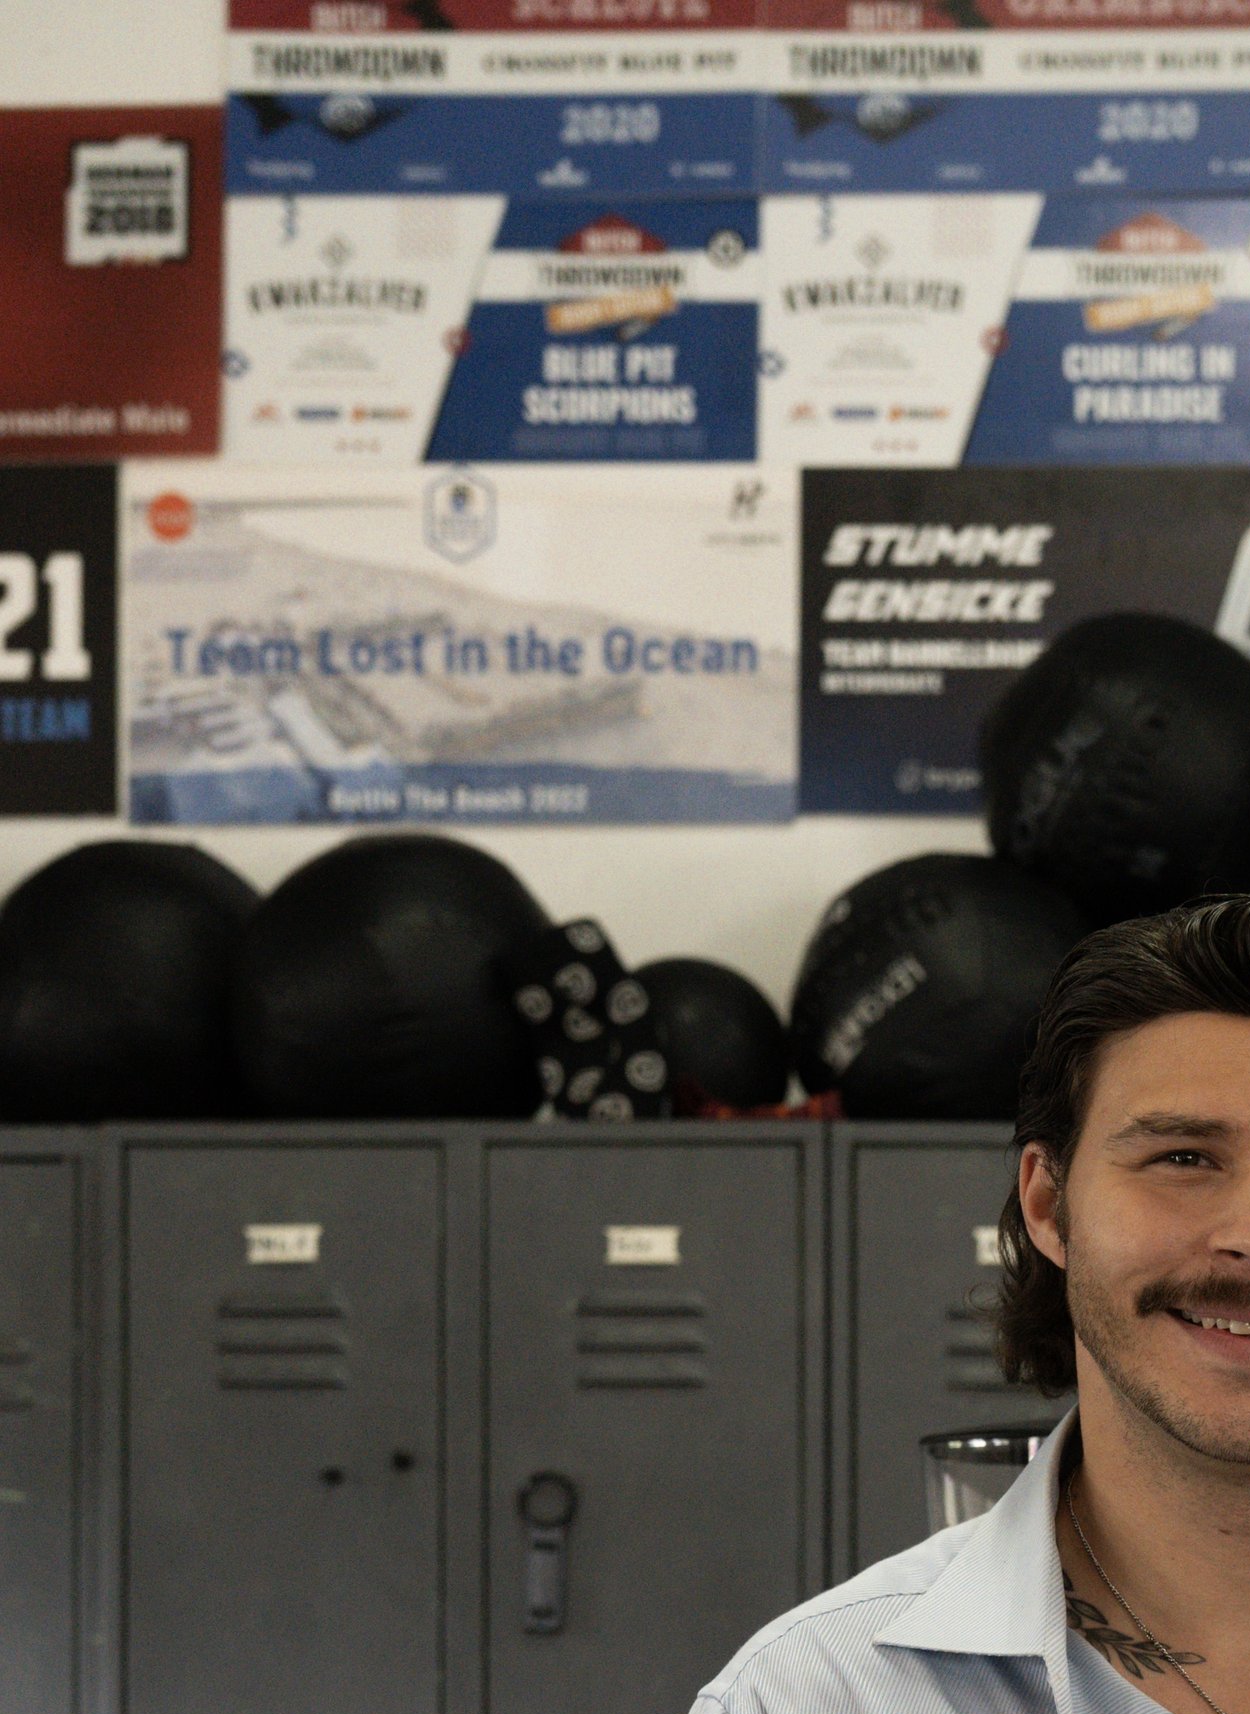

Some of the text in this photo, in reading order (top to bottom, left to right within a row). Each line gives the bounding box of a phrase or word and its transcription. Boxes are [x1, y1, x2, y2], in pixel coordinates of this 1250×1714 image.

[253, 44, 446, 80] THROWDOWN
[618, 52, 682, 72] BLUE
[693, 52, 738, 71] PIT
[790, 44, 982, 79] THROWDOWN
[1156, 50, 1220, 71] BLUE
[559, 104, 660, 145] 2020
[1099, 102, 1198, 142] 2020
[543, 346, 676, 382] BLUE PIT
[1061, 345, 1236, 382] CURLING IN
[523, 386, 697, 424] SCORPIONS
[1073, 386, 1224, 423] PARADISE
[822, 523, 1056, 567] STUMME
[165, 625, 759, 675] Team Lost in the Ocean
